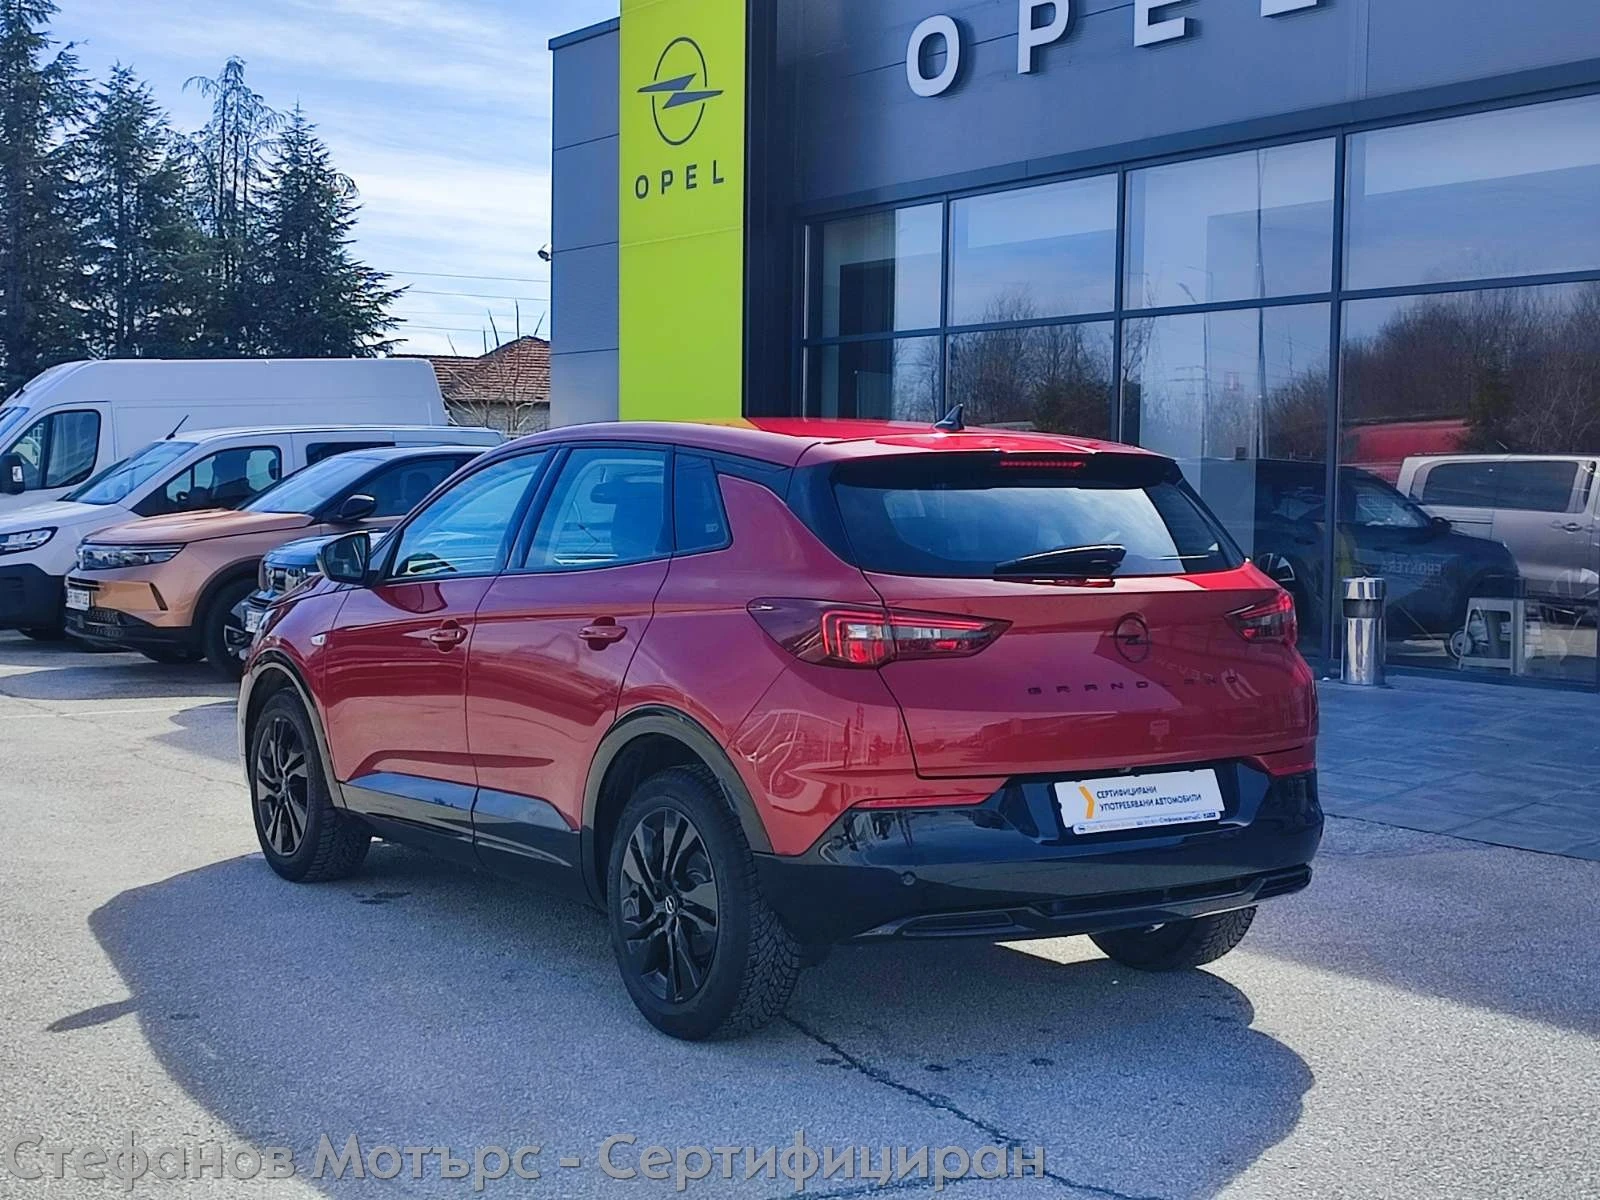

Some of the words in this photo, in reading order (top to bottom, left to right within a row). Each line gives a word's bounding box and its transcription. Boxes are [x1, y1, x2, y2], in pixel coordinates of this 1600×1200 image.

[906, 0, 1318, 97] OPE
[635, 159, 725, 200] OPEL
[1096, 785, 1157, 799] СЕРТИФИЦИРАНИ
[1099, 798, 1154, 812] УПОТРЕБЯВАНИ
[1155, 793, 1202, 806] АВТОМОБИЛИ
